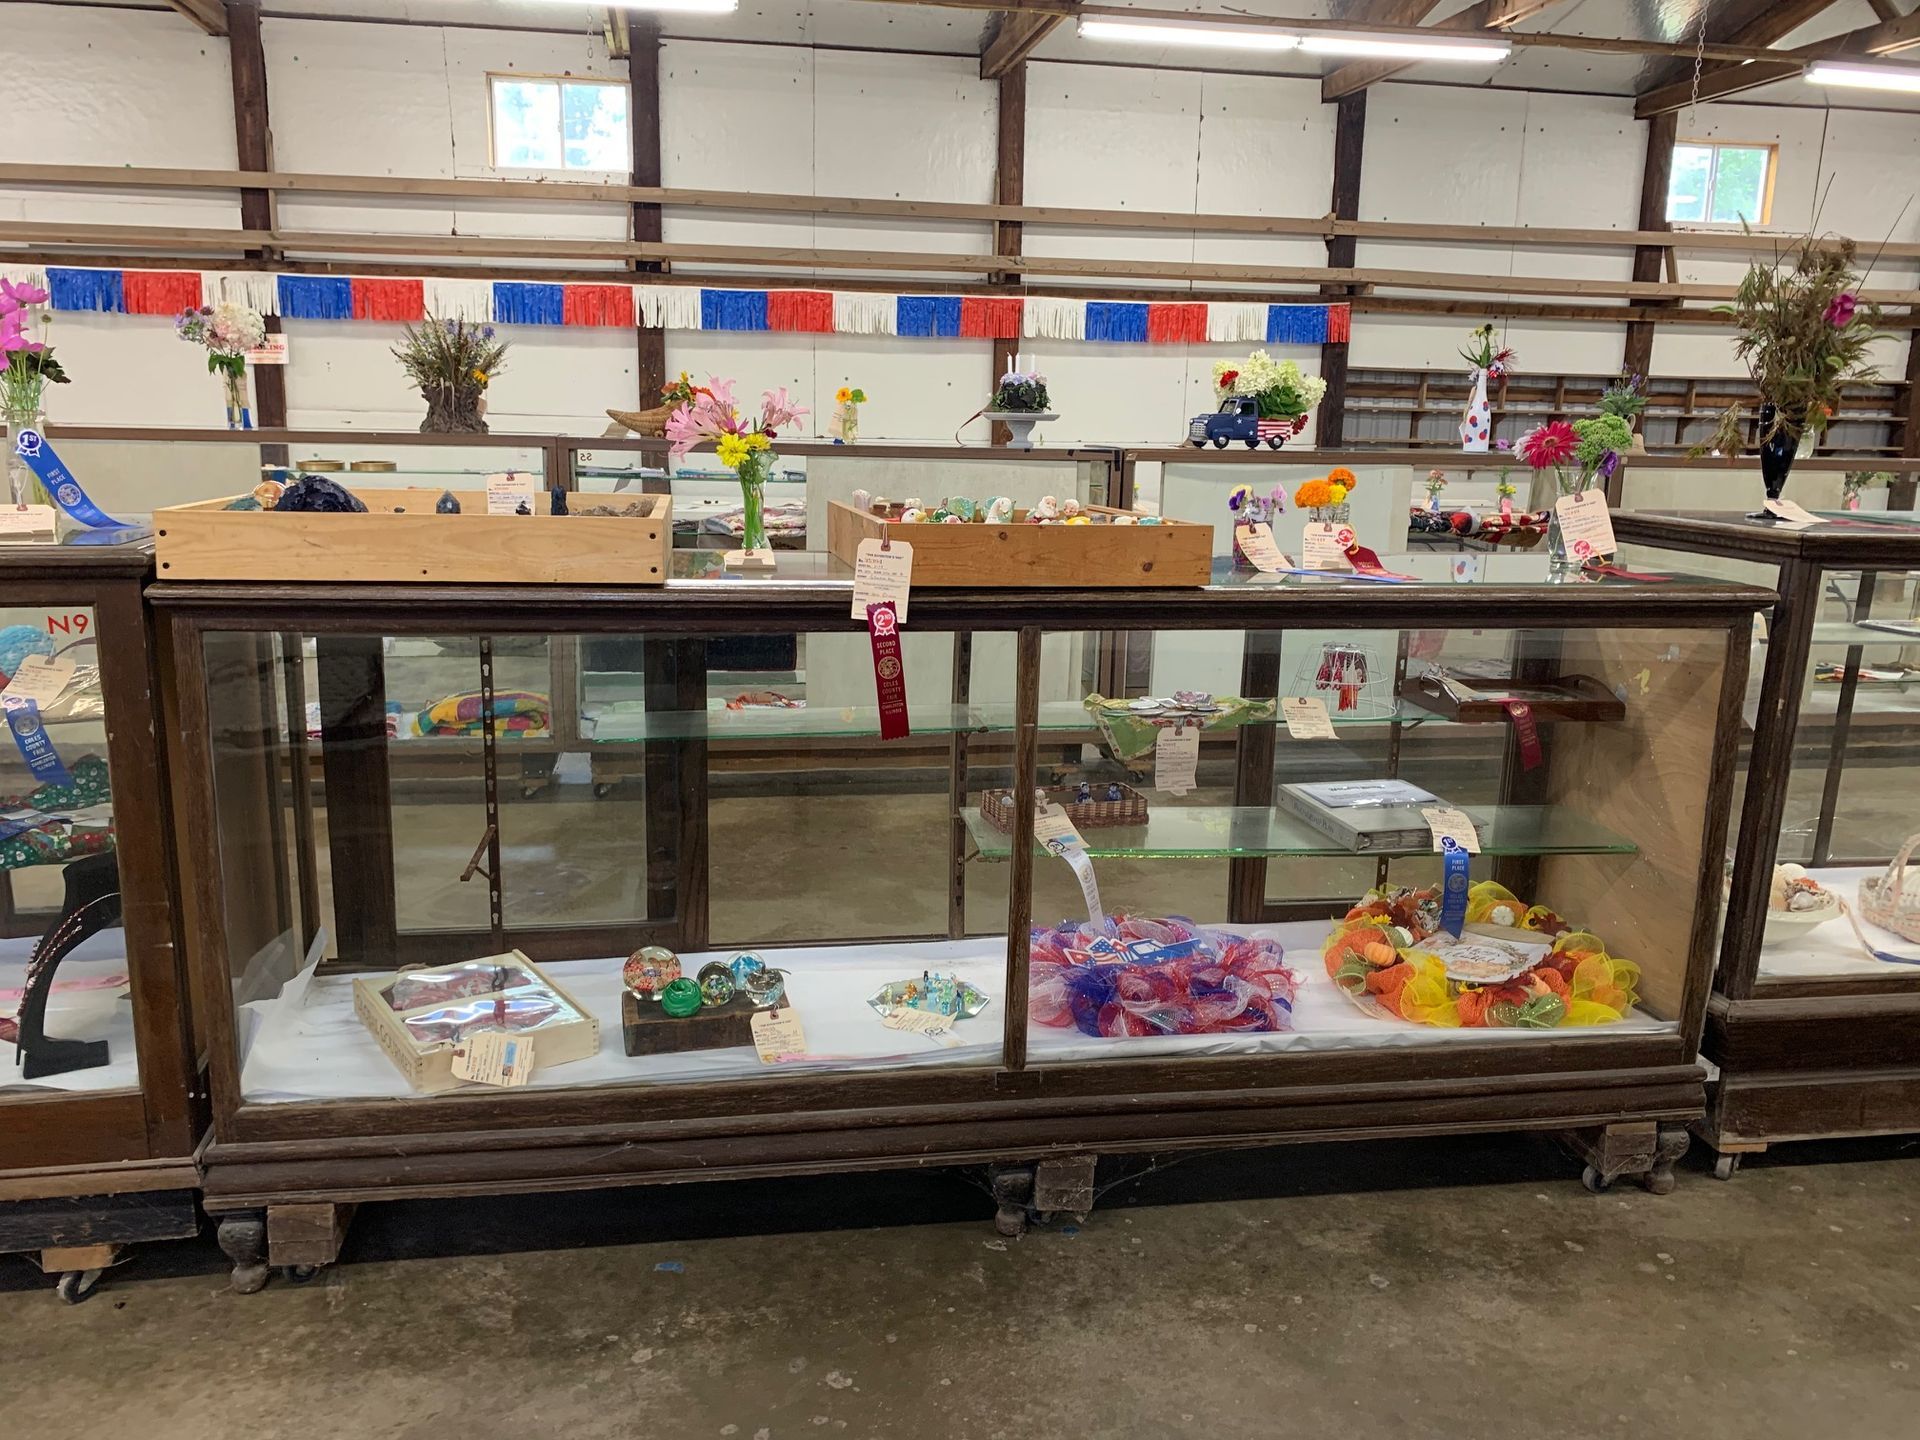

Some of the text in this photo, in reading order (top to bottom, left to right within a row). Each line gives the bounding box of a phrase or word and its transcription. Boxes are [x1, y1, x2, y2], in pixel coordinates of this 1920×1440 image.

[47, 468, 60, 478] FIRST
[51, 474, 66, 485] PLACE
[48, 614, 89, 634] N9
[878, 613, 891, 626] 2ND
[877, 641, 896, 649] SECOND
